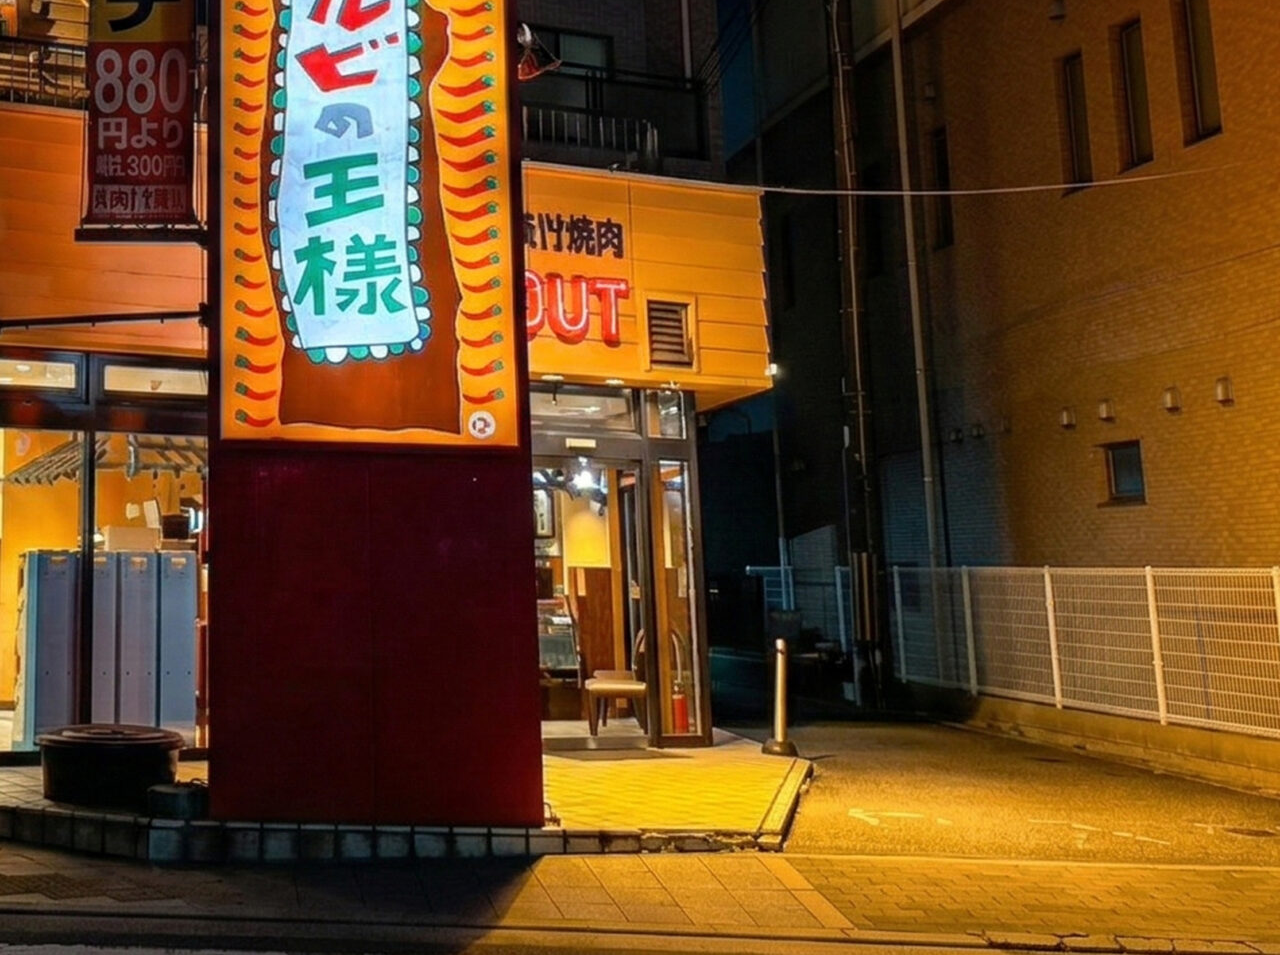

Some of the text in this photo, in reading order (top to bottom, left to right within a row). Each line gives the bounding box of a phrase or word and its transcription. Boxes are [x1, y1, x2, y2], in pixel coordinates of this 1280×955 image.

[94, 48, 188, 114] 880
[97, 117, 184, 149] 円より
